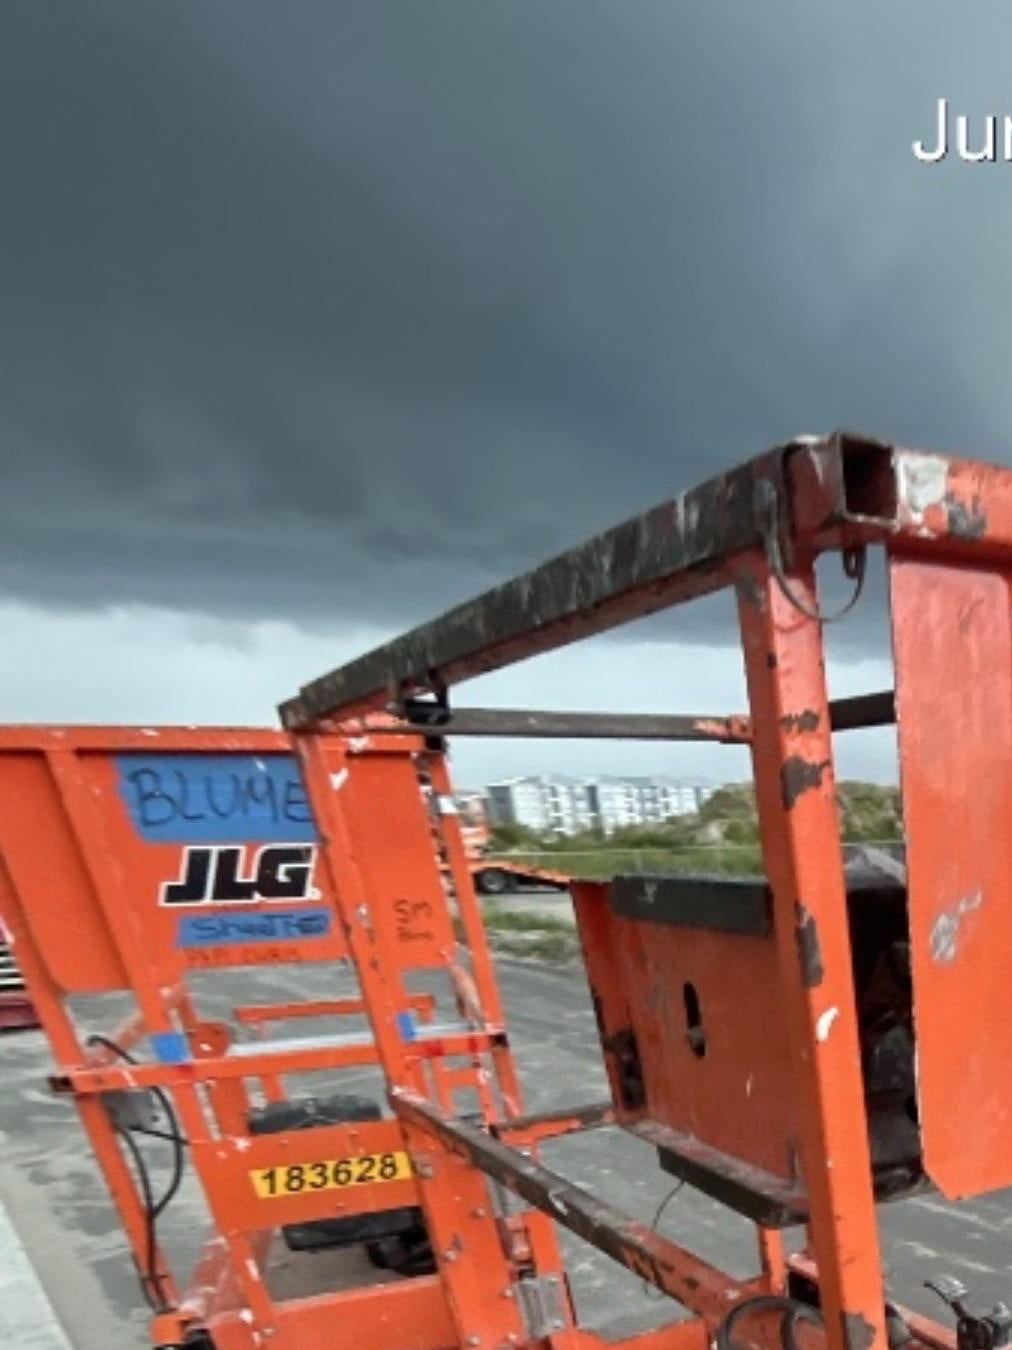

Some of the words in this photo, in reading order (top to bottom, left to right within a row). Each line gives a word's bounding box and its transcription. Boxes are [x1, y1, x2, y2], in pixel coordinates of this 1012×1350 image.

[127, 766, 316, 828] BLUME
[158, 843, 321, 907] JLG
[260, 1152, 399, 1196] 183628
